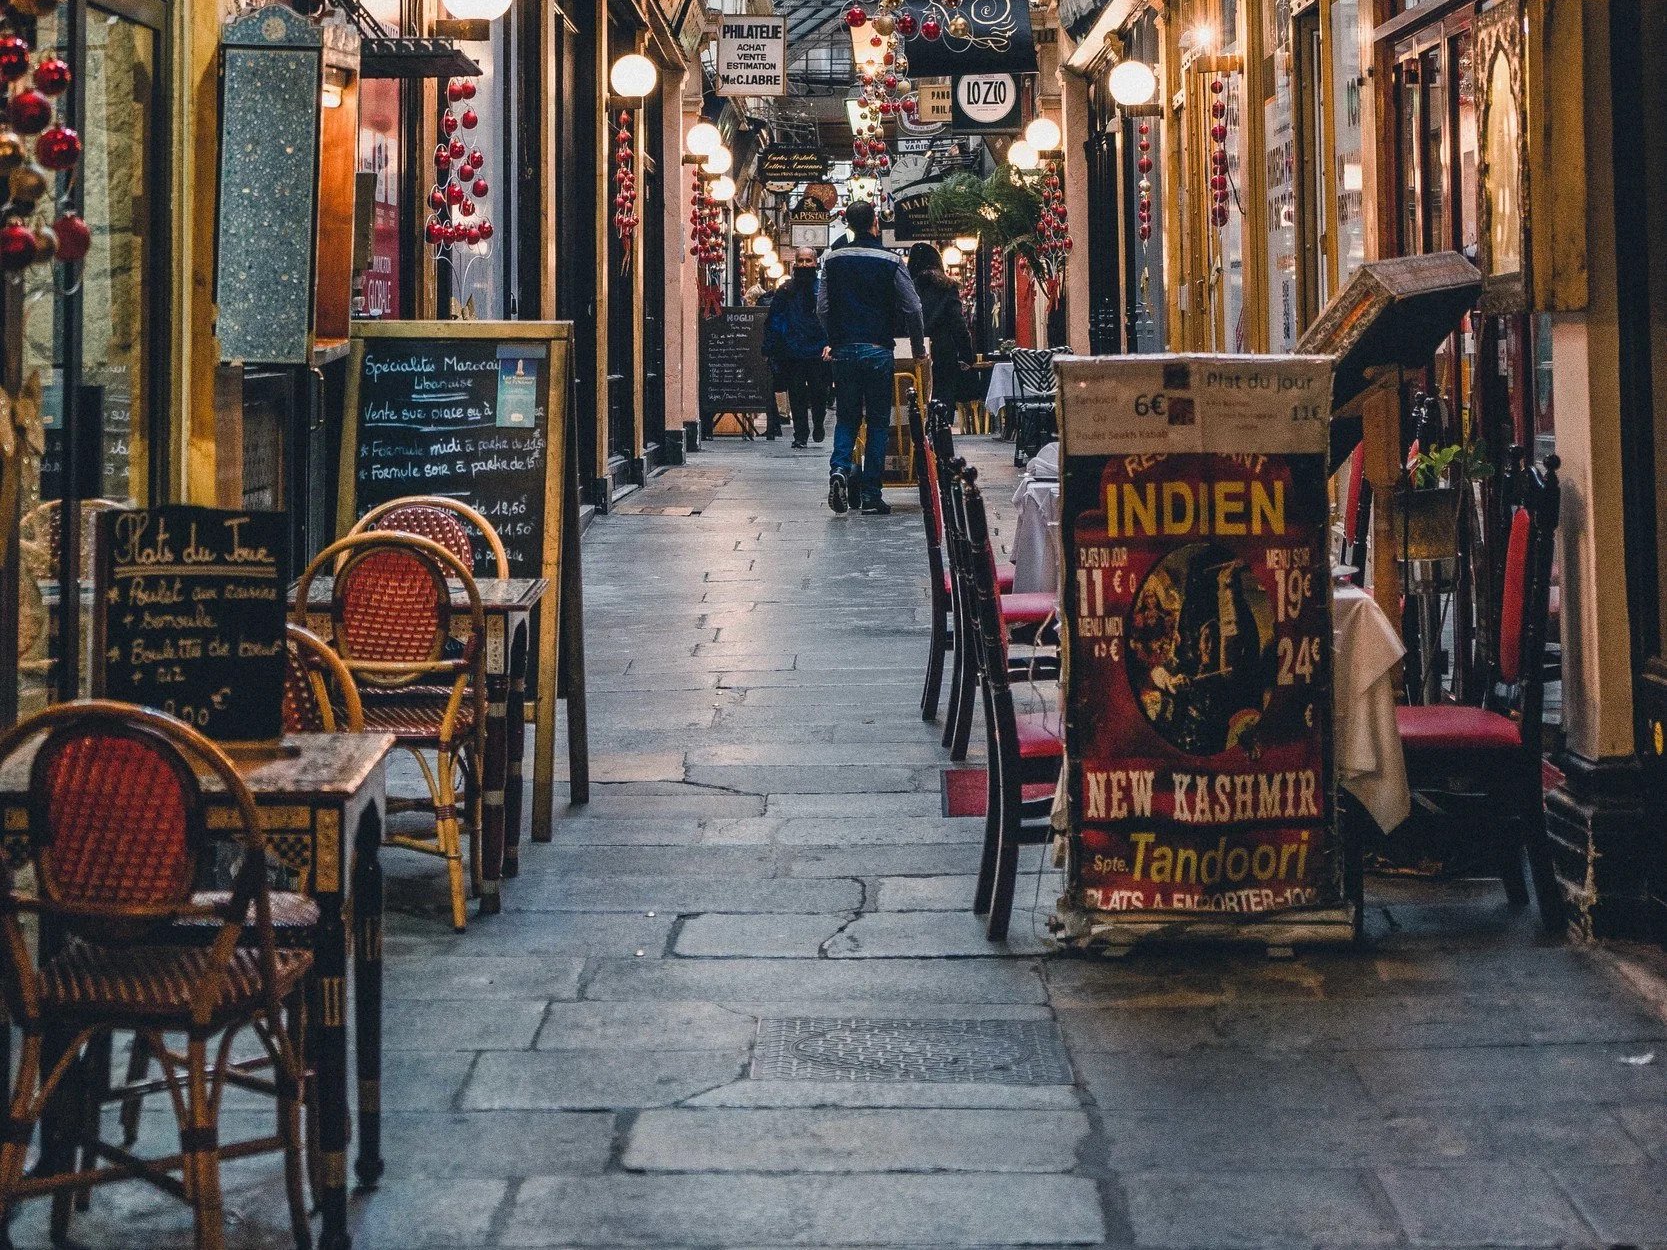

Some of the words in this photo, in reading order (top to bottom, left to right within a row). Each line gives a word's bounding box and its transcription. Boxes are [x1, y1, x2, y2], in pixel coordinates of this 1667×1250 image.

[736, 43, 767, 51] ACHAT
[736, 53, 767, 61] VENTE
[726, 62, 776, 70] ESTIMATION
[414, 376, 474, 389] Libanaise
[1206, 372, 1241, 389] Plat
[1248, 372, 1270, 389] du
[1277, 373, 1313, 393] jour
[364, 401, 398, 420] Vente
[1134, 393, 1166, 416] 6€
[430, 437, 462, 456] midi
[1105, 480, 1286, 538] INDIEN
[183, 522, 217, 563] du
[1266, 548, 1291, 569] MENU
[1078, 616, 1102, 637] MENU
[1086, 770, 1155, 820] NEW
[1172, 768, 1319, 823] KASHMIR
[1129, 830, 1310, 883] Tandoori
